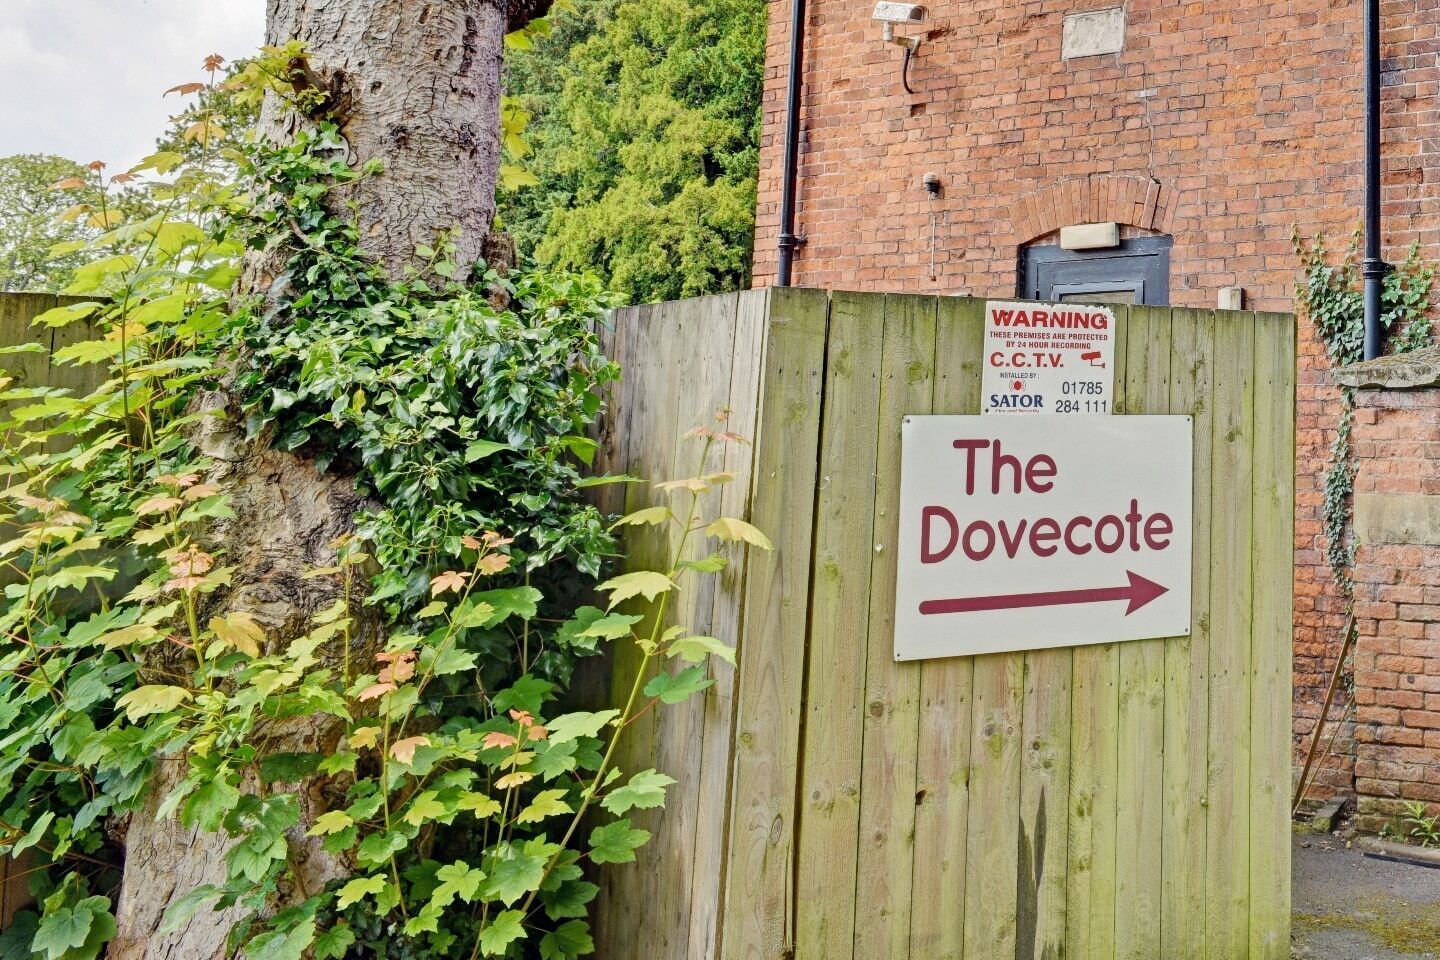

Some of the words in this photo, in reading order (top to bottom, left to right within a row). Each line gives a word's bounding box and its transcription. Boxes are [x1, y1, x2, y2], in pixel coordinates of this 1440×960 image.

[992, 309, 1108, 329] WARNING
[990, 331, 1011, 339] THESE
[1013, 331, 1050, 340] PREMISES
[1052, 332, 1066, 340] ARE
[1068, 333, 1108, 341] PROTECTED
[1006, 340, 1015, 348] BY
[1028, 341, 1049, 349] HOUR
[1051, 342, 1091, 350] RECORDING
[990, 351, 1064, 368] C.C.T.V.
[1062, 381, 1103, 395] 01785
[990, 394, 1044, 408] SATOR
[1055, 399, 1080, 413] 284
[1084, 400, 1107, 414] 111
[952, 439, 1058, 496] The
[920, 498, 1174, 564] Dovecote
